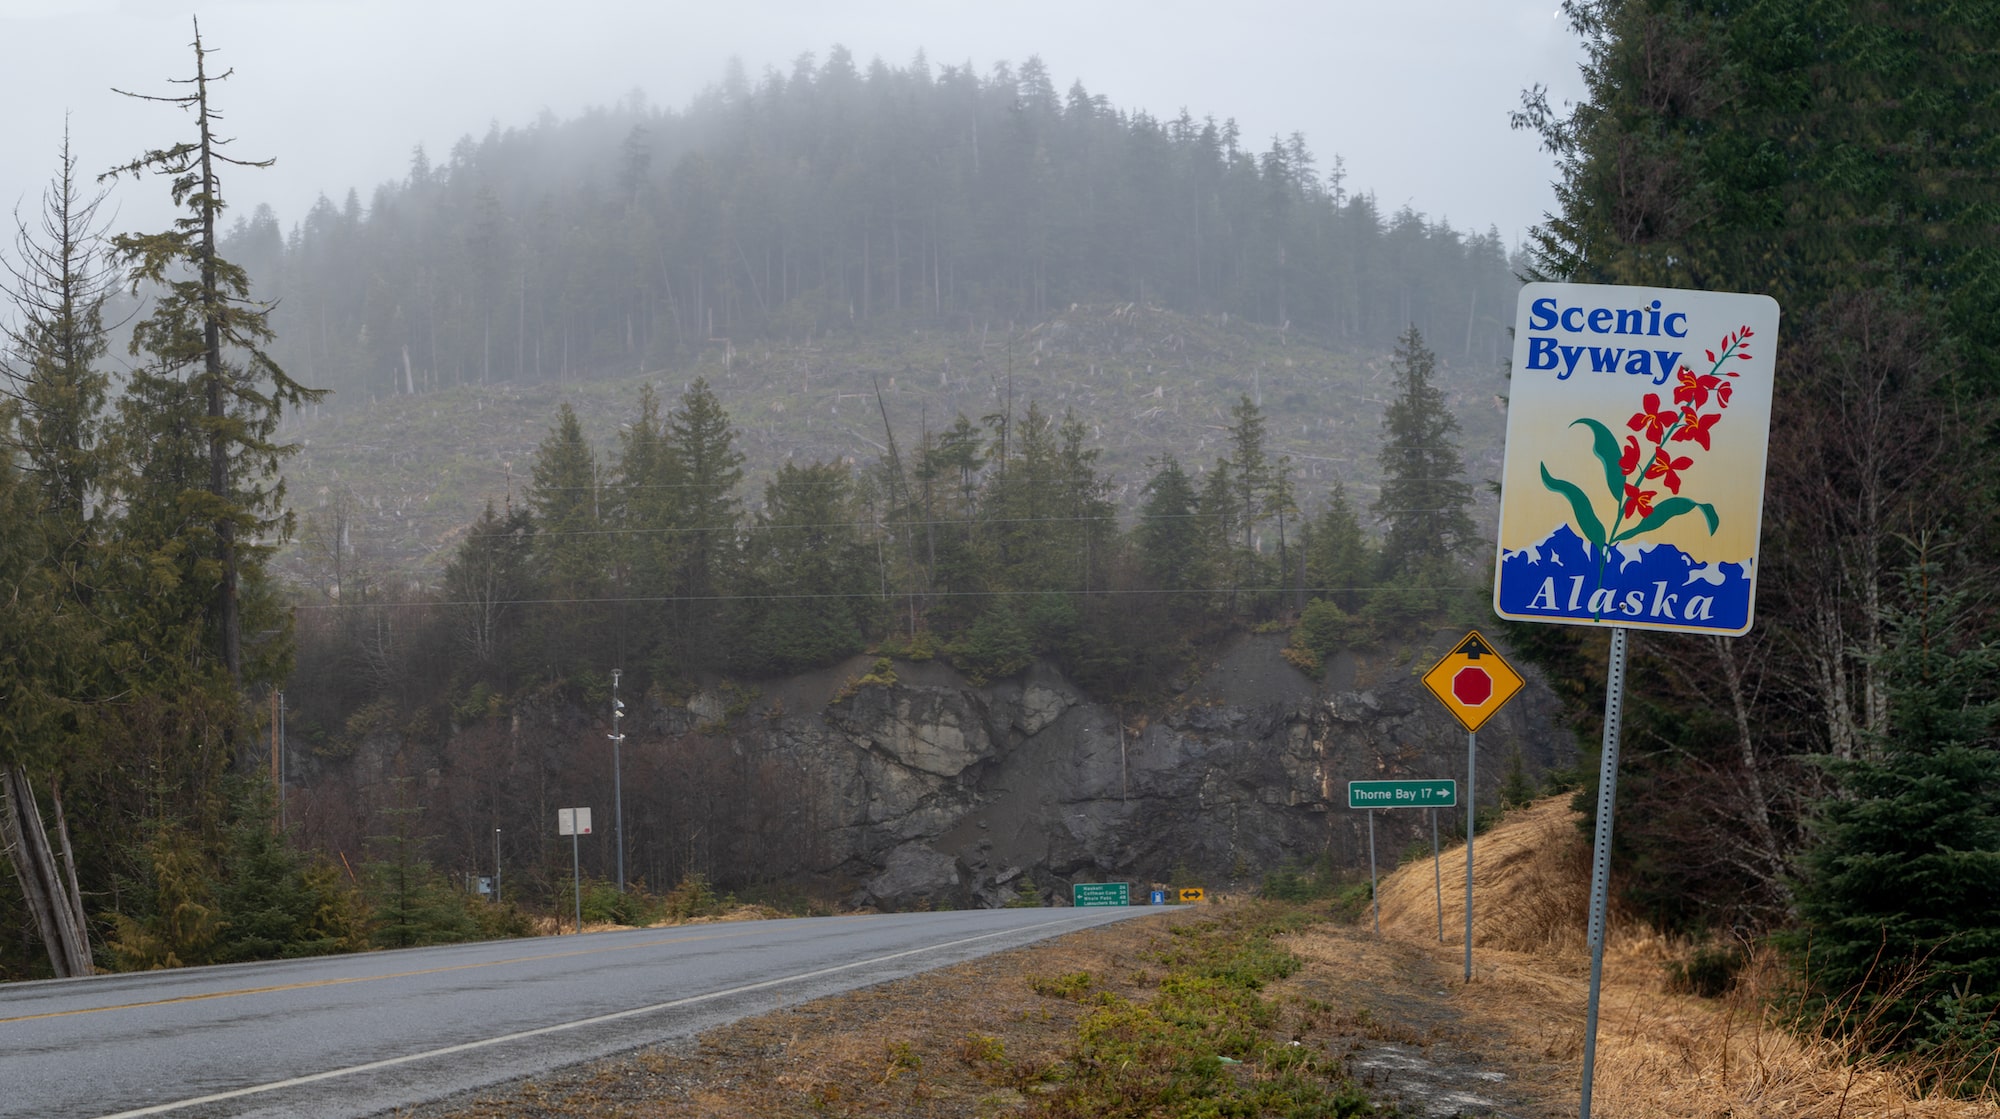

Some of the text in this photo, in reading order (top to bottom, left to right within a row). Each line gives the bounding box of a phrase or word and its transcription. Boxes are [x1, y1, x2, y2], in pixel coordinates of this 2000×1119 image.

[1529, 298, 1688, 338] Scenic
[1525, 337, 1682, 385] Byway
[1526, 575, 1714, 621] Alaska
[1354, 788, 1432, 801] Thorne Bay 17
